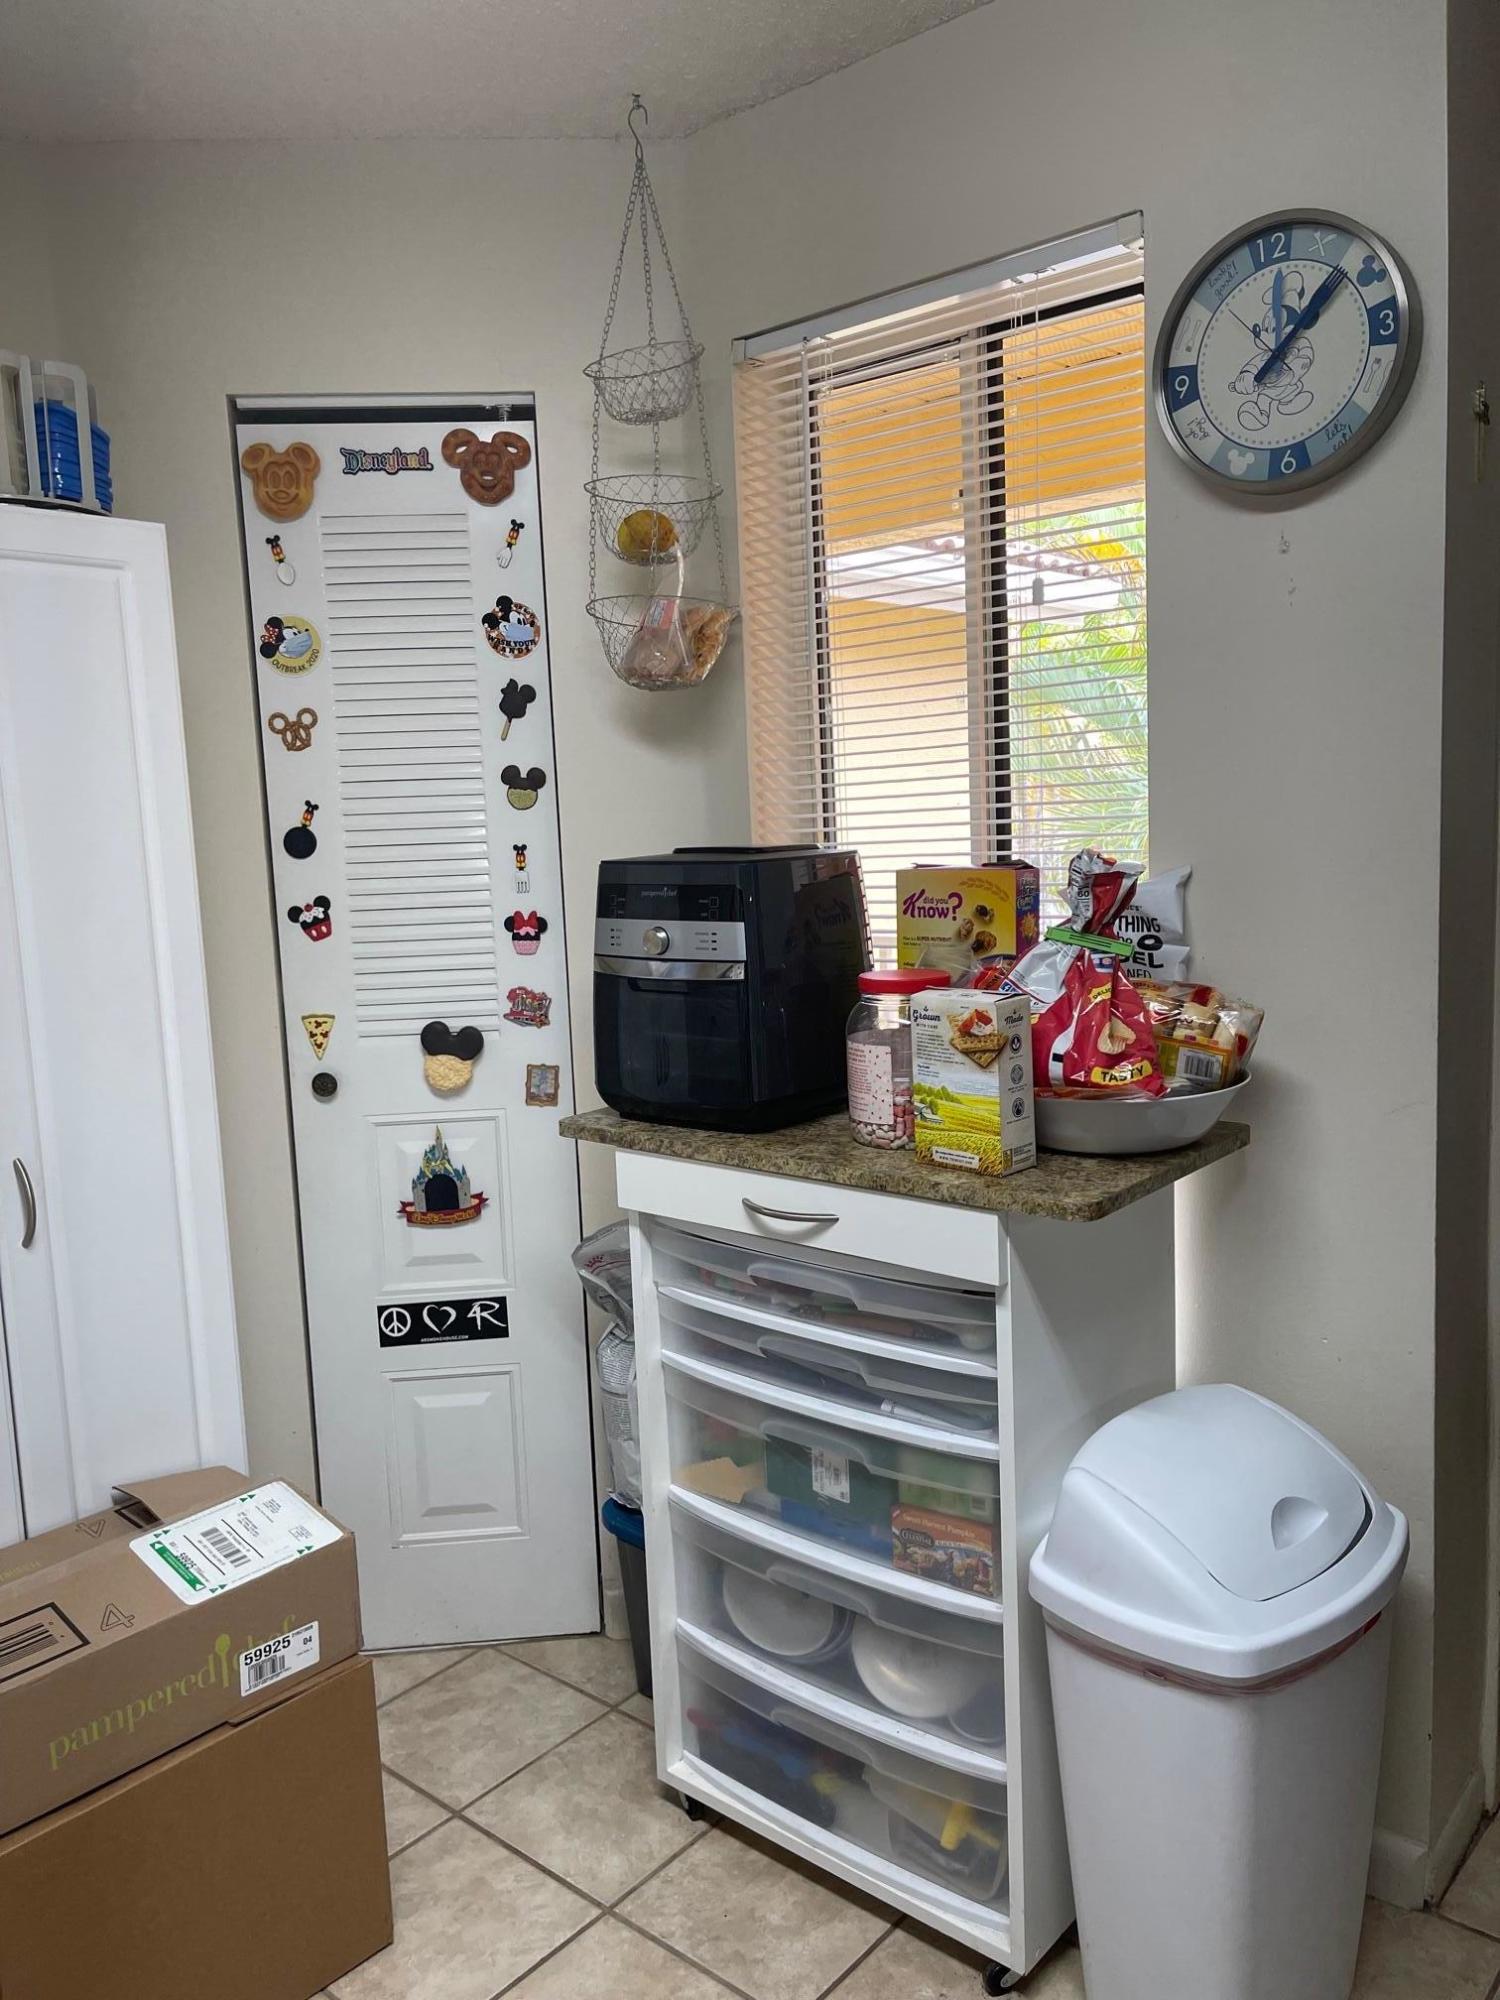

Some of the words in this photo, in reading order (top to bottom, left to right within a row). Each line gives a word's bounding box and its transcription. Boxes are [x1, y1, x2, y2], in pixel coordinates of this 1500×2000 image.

[1256, 231, 1287, 263] 12
[1379, 309, 1395, 336] 3
[1174, 375, 1190, 399] 9
[341, 448, 432, 473] Disneyland
[1280, 450, 1297, 474] 6
[306, 648, 320, 667] 2020
[243, 1635, 291, 1667] 59925
[48, 1648, 217, 1770] pampered
